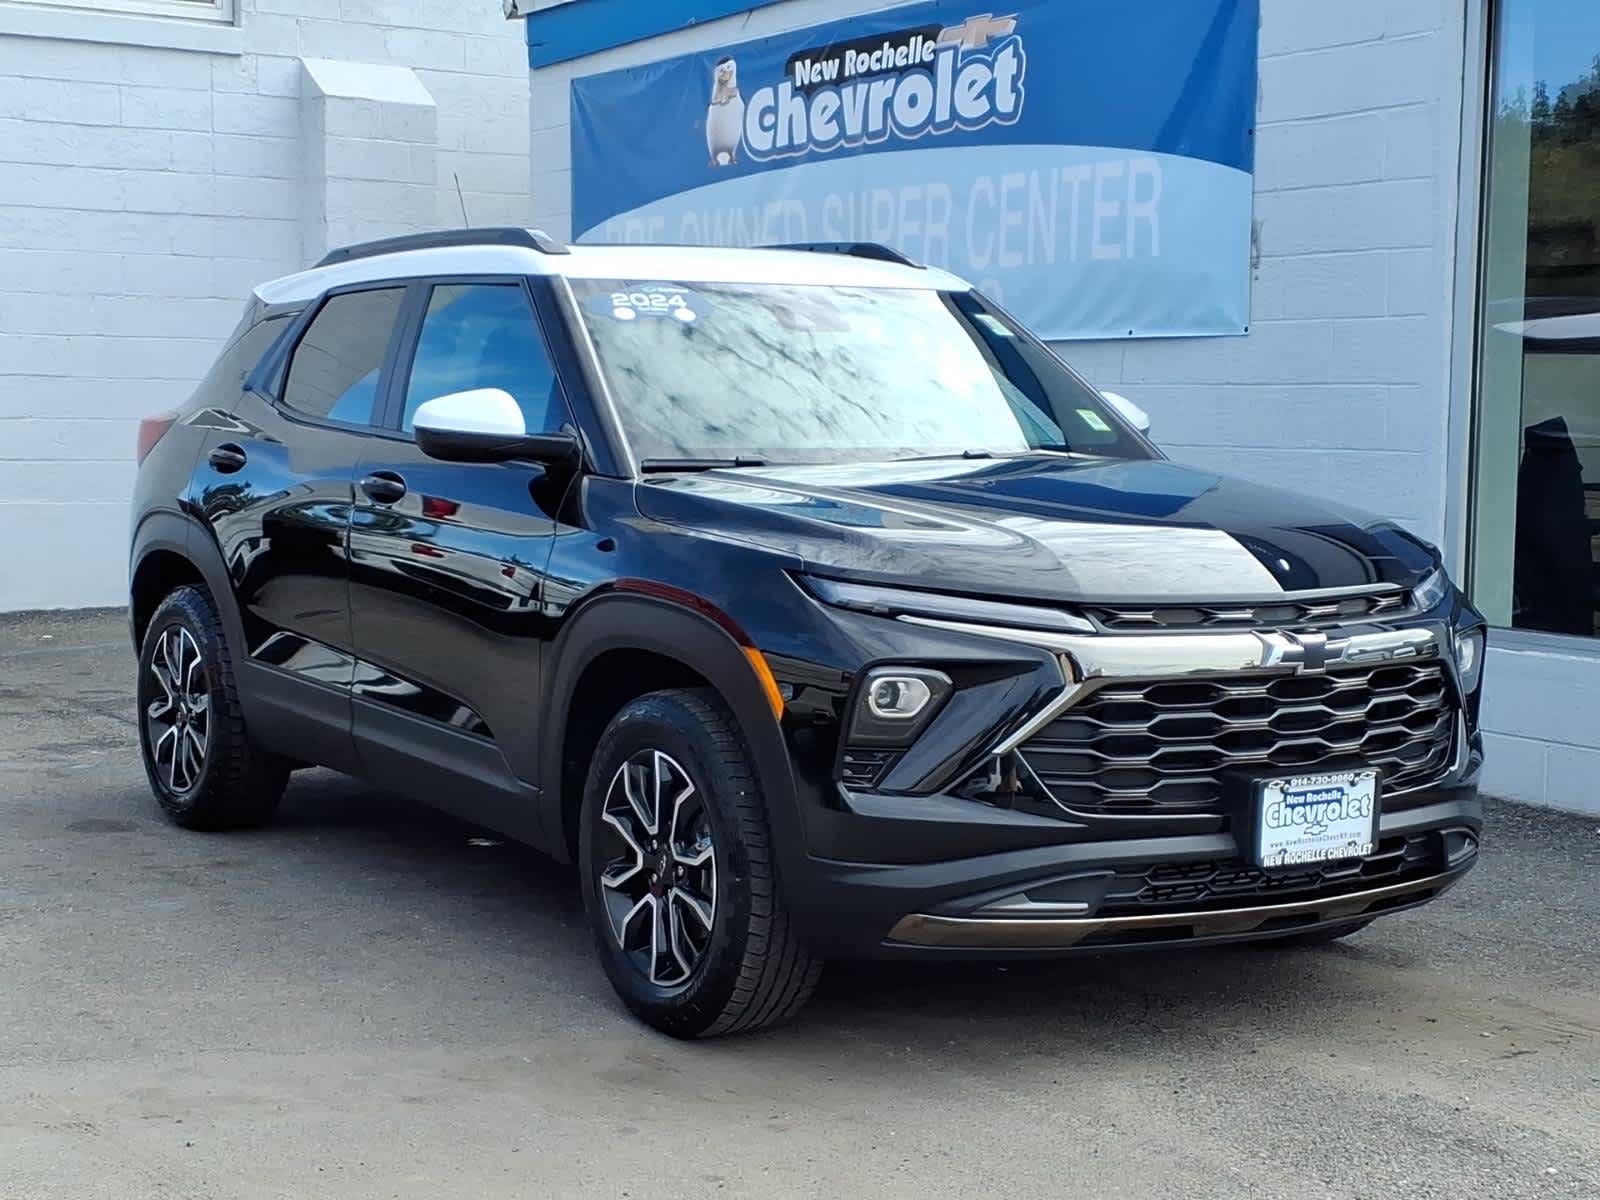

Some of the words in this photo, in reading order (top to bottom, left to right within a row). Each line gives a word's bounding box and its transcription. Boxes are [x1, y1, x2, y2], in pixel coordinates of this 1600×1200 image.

[794, 54, 840, 87] New
[844, 33, 936, 77] Rochelle
[744, 43, 1020, 151] Chevrolet
[966, 157, 1163, 270] CENTER
[610, 292, 688, 308] 2024
[1265, 794, 1372, 829] Chevrolet
[1286, 793, 1305, 805] New
[1306, 789, 1343, 803] Rochelle
[1263, 854, 1283, 868] NEW
[1284, 847, 1327, 864] ROCHELLE
[1328, 843, 1373, 860] CHEVROLET
